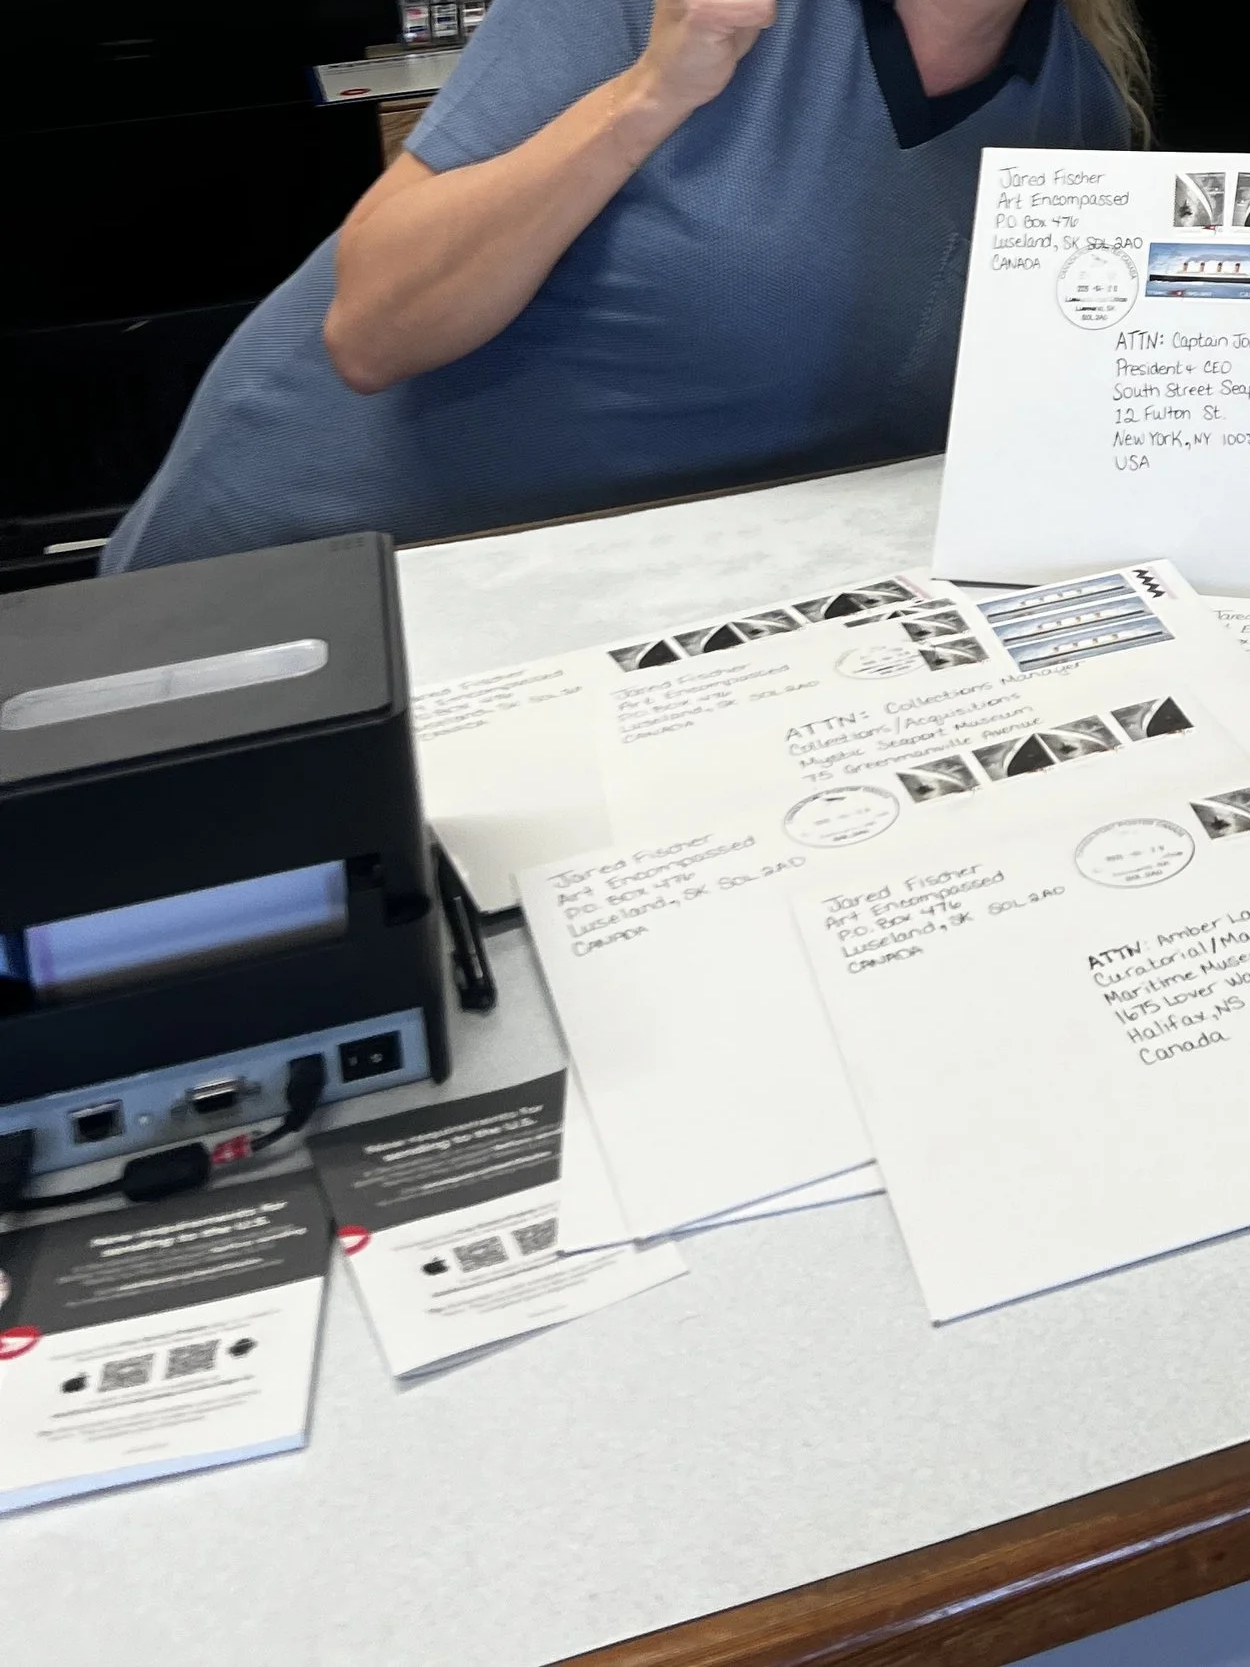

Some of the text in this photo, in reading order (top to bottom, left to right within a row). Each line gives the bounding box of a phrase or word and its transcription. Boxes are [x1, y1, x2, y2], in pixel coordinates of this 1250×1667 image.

[1115, 329, 1165, 351] ATTN:
[1172, 332, 1229, 351] Captain
[1116, 358, 1232, 377] President CEO
[1112, 384, 1161, 401] South
[1165, 382, 1213, 398] Street
[1115, 408, 1140, 425] 12
[1144, 404, 1191, 421] Fulton
[1112, 431, 1145, 448] New
[1194, 433, 1212, 445] NY
[1115, 454, 1151, 471] USA
[1157, 918, 1221, 946] Amber
[1103, 971, 1198, 1006] Maritime
[1115, 999, 1161, 1025] 1675
[1214, 995, 1246, 1016] NS
[1139, 1031, 1232, 1066] Canada
